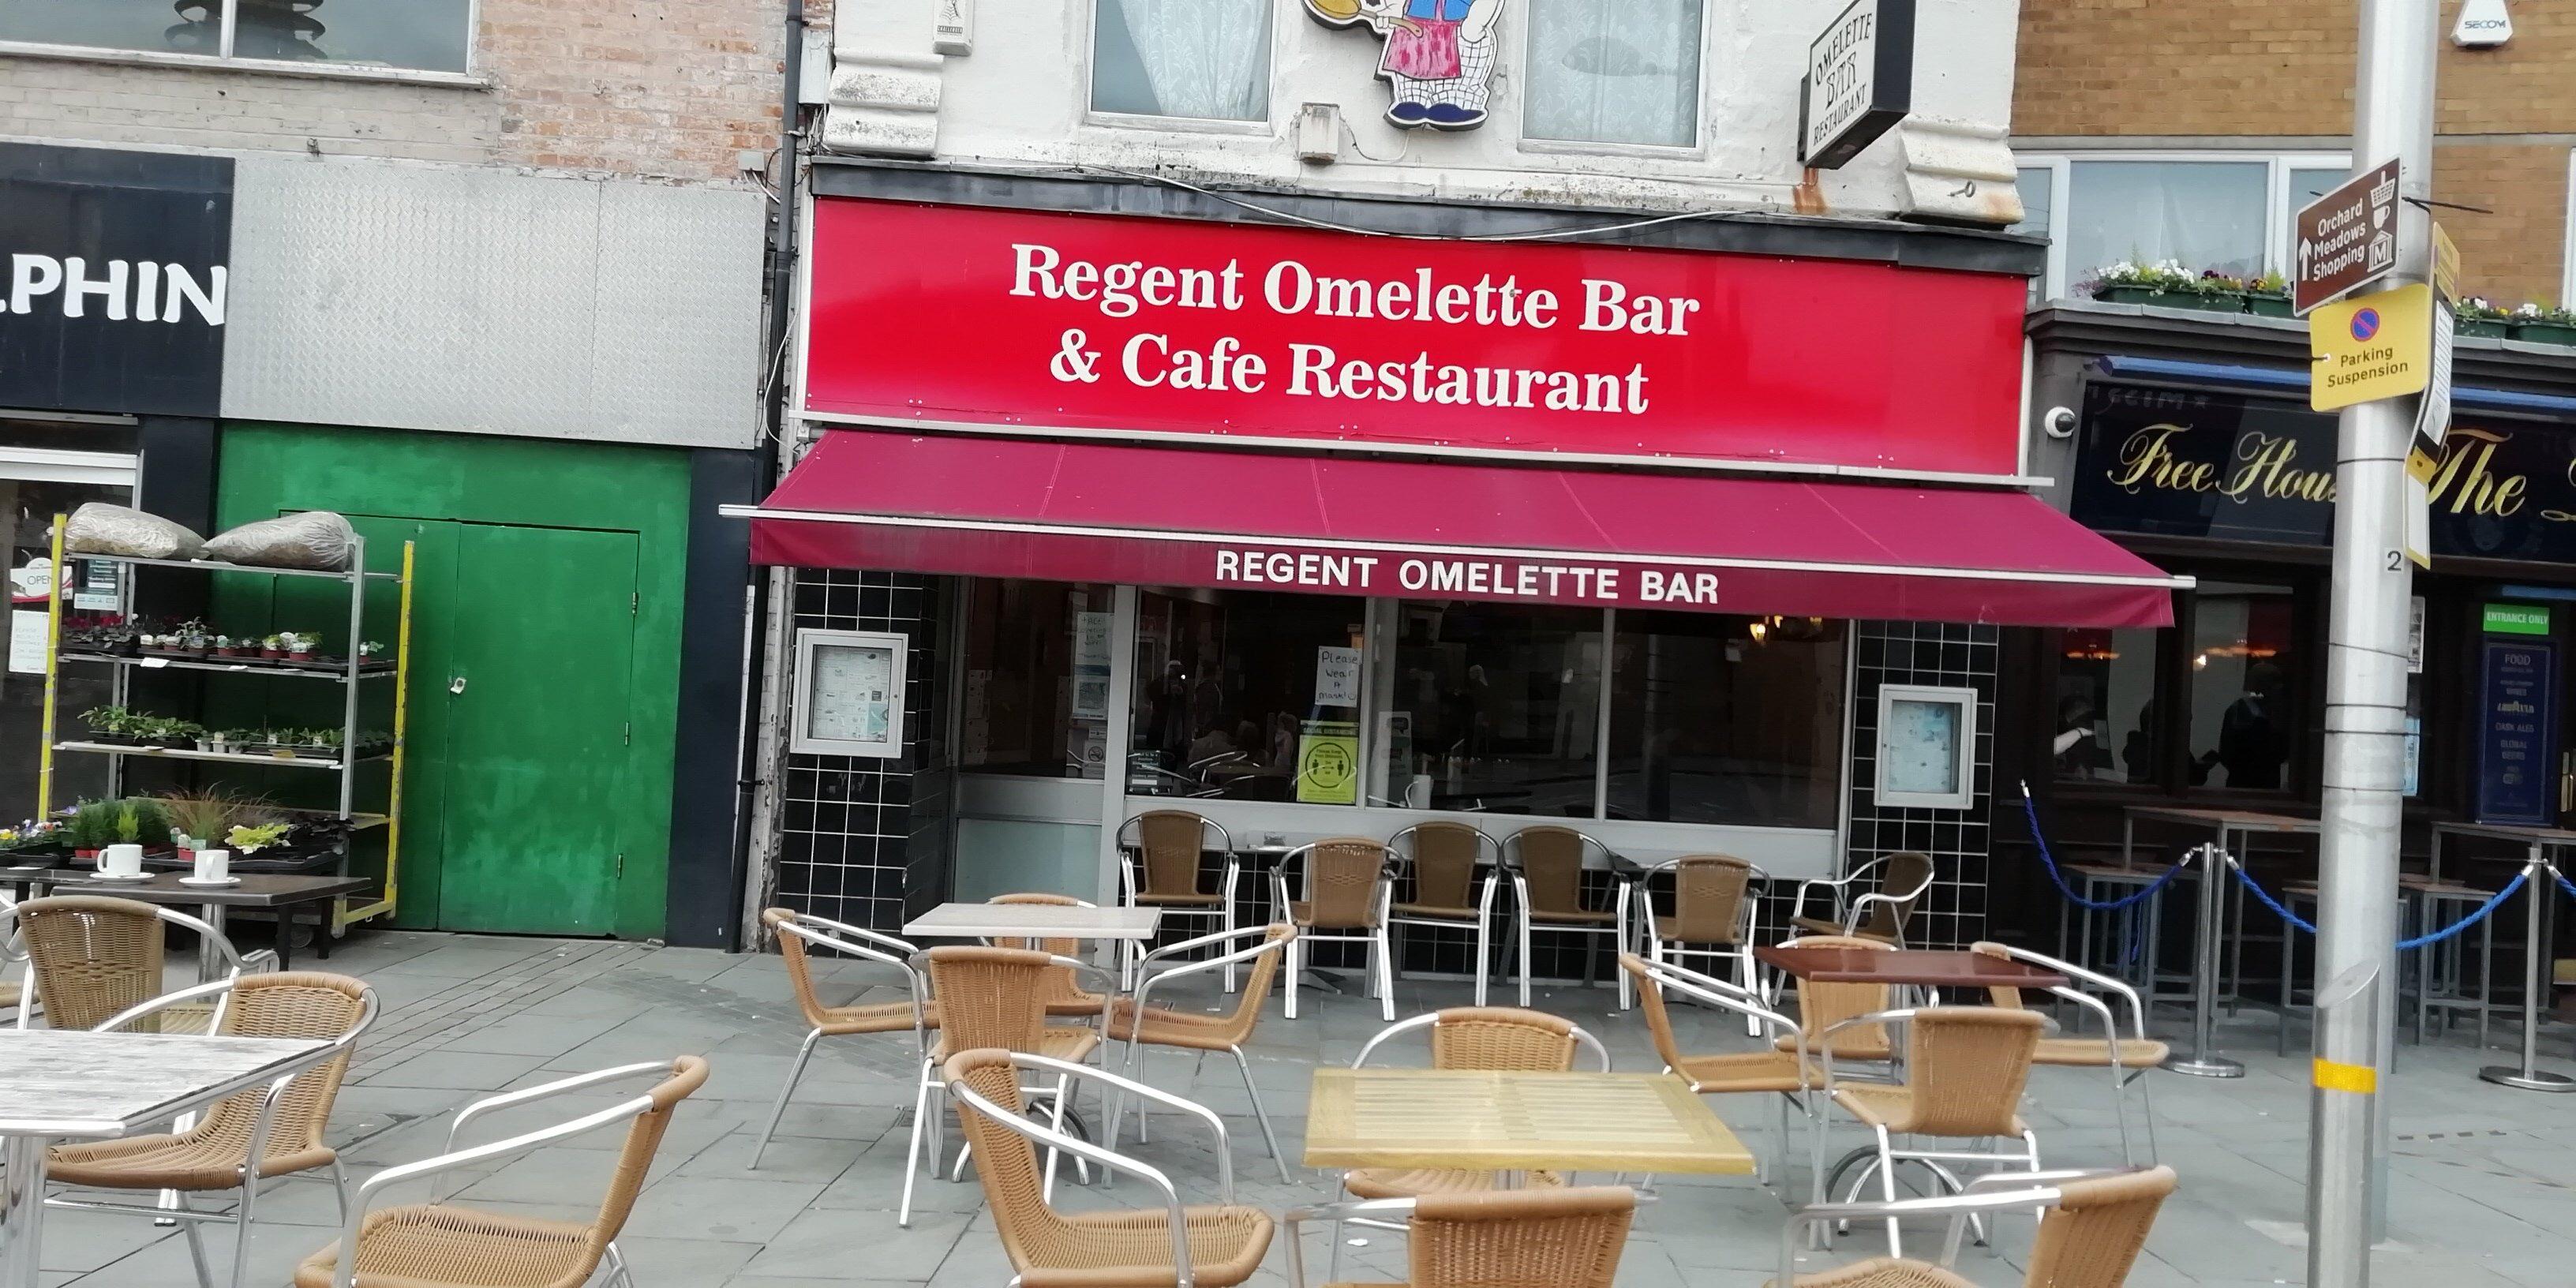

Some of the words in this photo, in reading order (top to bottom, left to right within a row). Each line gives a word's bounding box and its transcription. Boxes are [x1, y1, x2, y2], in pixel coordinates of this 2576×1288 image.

[2464, 20, 2507, 29] SECOM
[1815, 13, 1873, 87] OMELETTE
[1825, 51, 1857, 110] BAR
[1814, 81, 1866, 147] RESTAURANT
[2317, 197, 2363, 237] Orchard
[2314, 221, 2366, 260] Meadows
[2313, 244, 2365, 282] Shopping
[0, 253, 227, 326] PHIN
[1009, 242, 1245, 318] Regent
[1264, 260, 1559, 330] Omelette
[1578, 278, 1701, 336] Bar
[1049, 328, 1103, 384] &
[1121, 332, 1267, 394] Cafe
[1285, 342, 1650, 416] Restaurant
[2327, 361, 2409, 388] Suspension
[2340, 347, 2394, 368] Parking
[2106, 422, 2215, 496] Free
[2427, 428, 2527, 518] The
[1215, 549, 1380, 590] REGENT
[1398, 558, 1620, 601] OMELETTE
[1639, 568, 1720, 606] BAR
[2387, 550, 2402, 571] 2
[2486, 611, 2527, 623] ENTRANCE
[2528, 614, 2548, 625] ONLY
[1321, 650, 1358, 665] Please
[2504, 653, 2531, 665] FOOD
